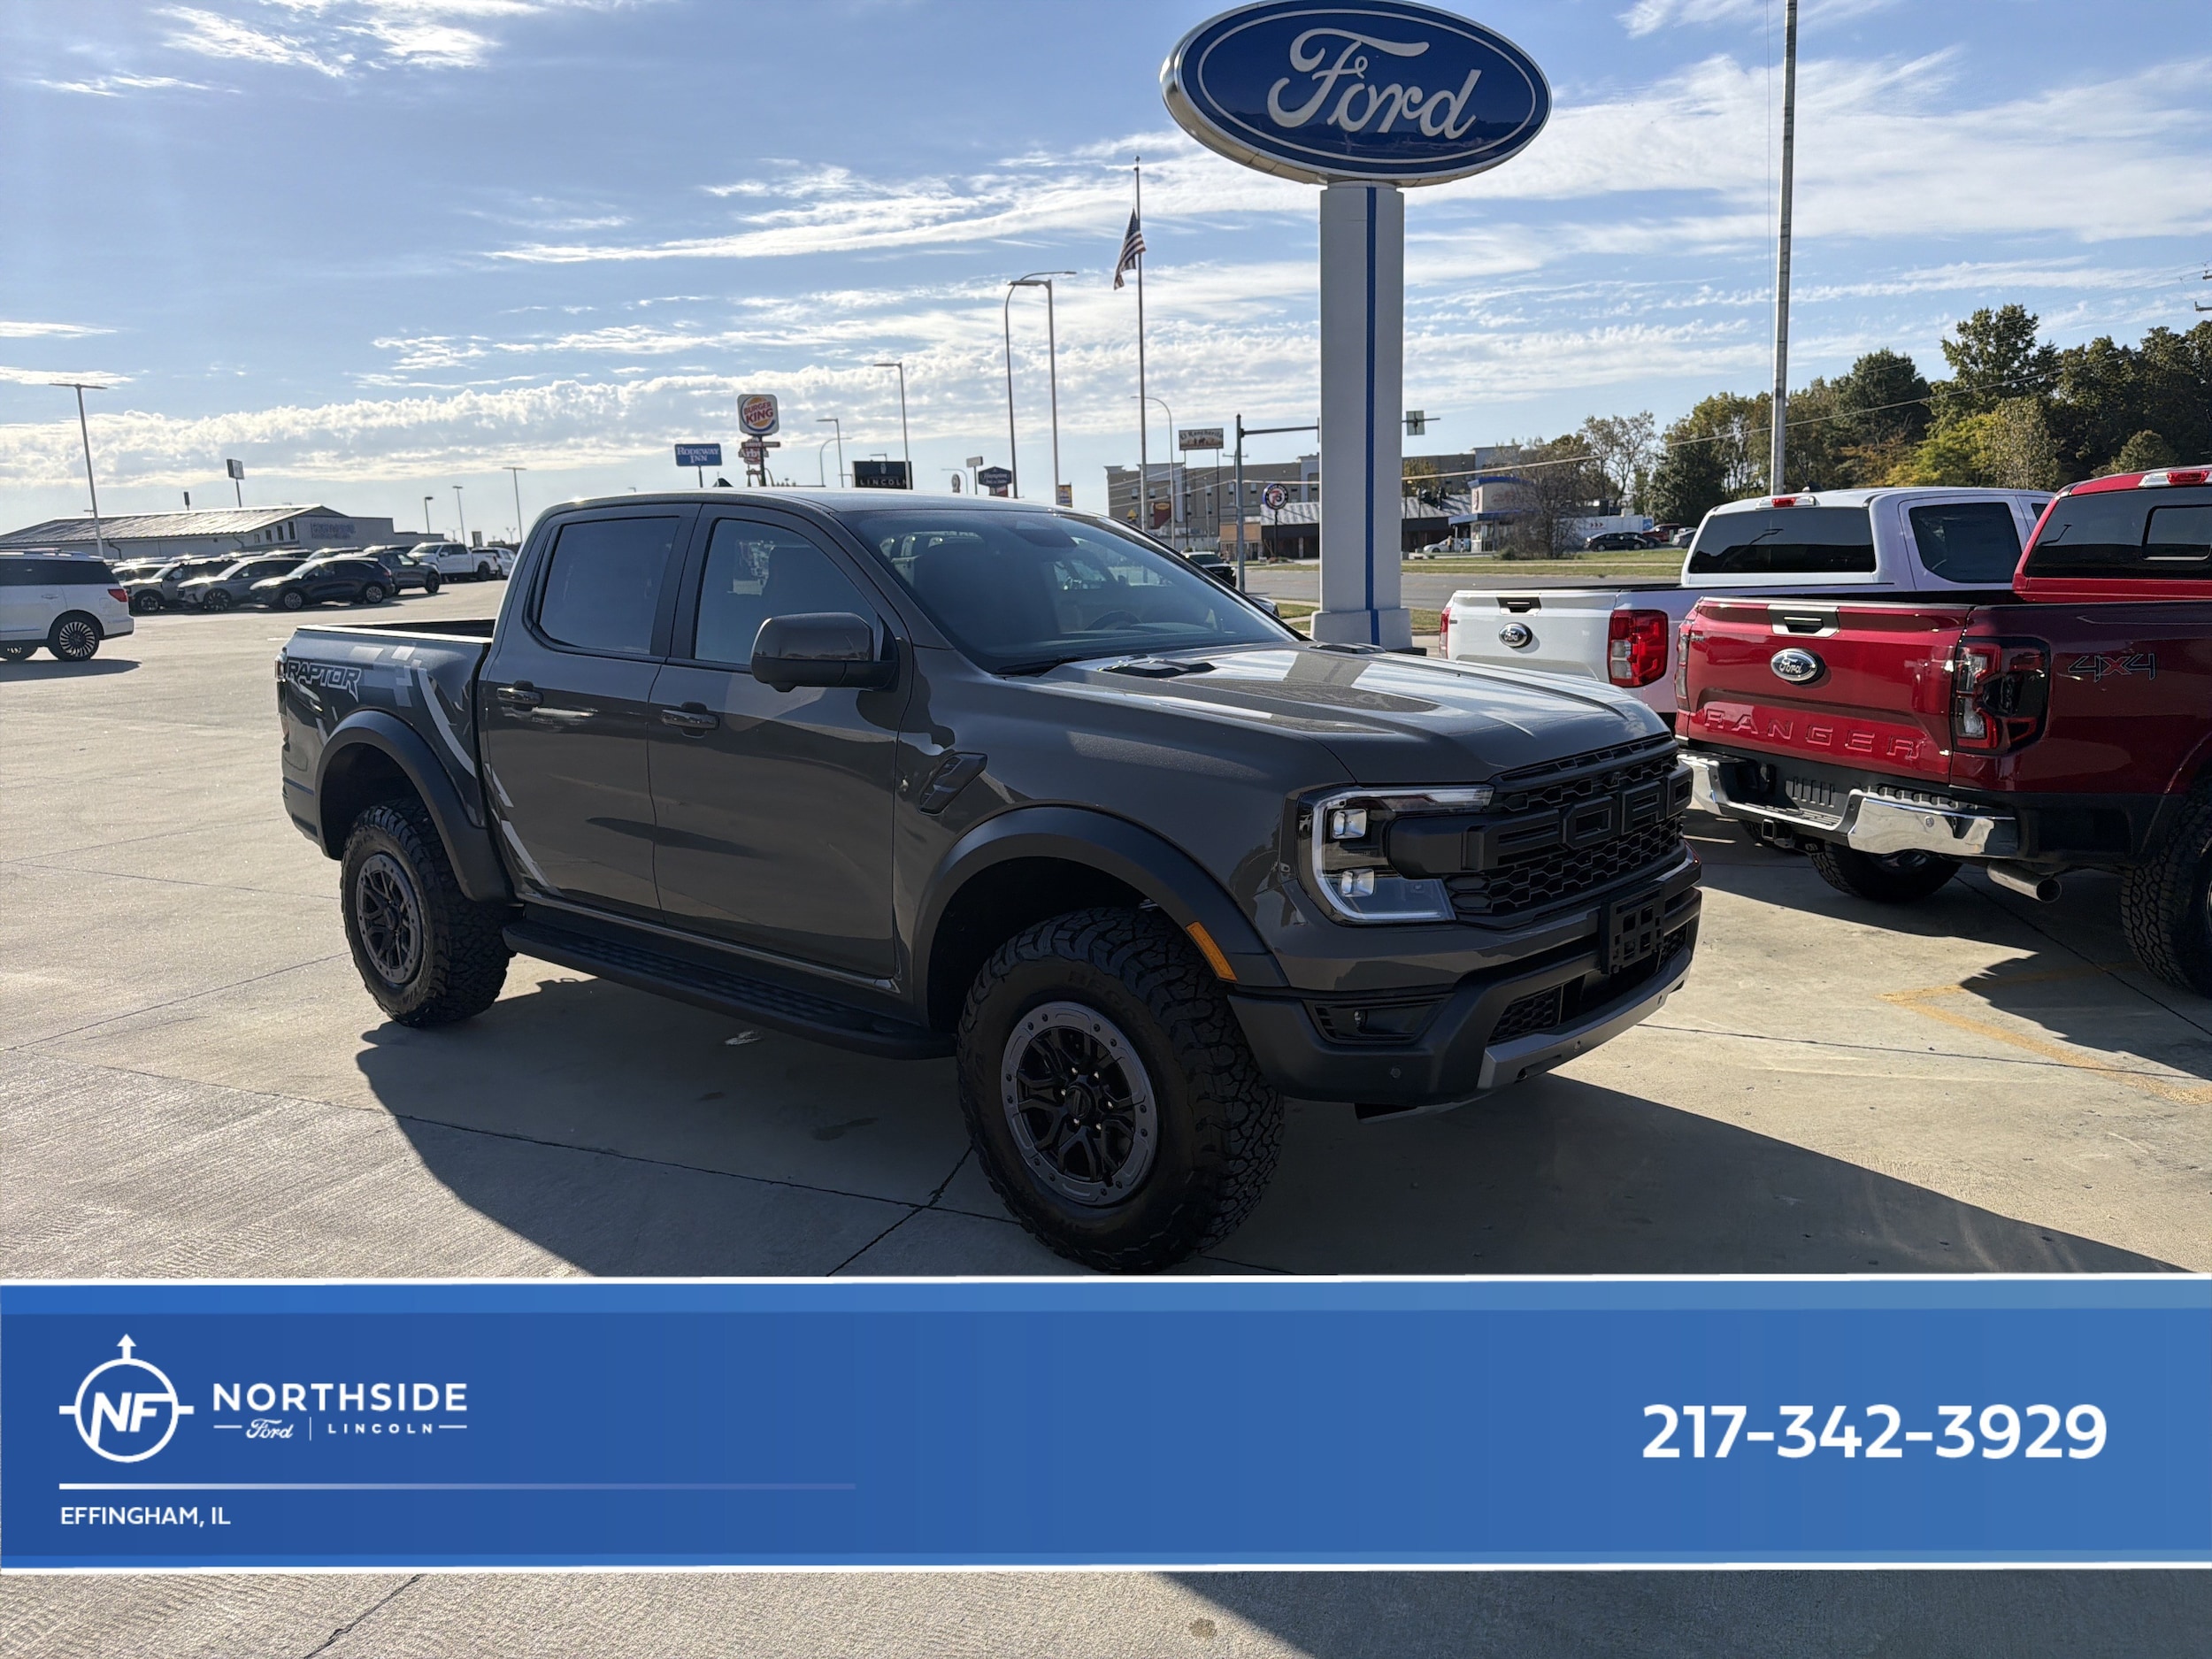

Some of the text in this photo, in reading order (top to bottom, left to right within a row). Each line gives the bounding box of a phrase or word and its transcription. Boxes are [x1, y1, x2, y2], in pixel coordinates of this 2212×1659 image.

[1267, 27, 1482, 140] Ford
[744, 402, 772, 415] BURGER
[746, 408, 773, 424] KING
[690, 455, 708, 464] INN
[1778, 657, 1803, 674] Ford
[286, 660, 362, 703] RAPTOR
[1704, 709, 1924, 760] RANGER
